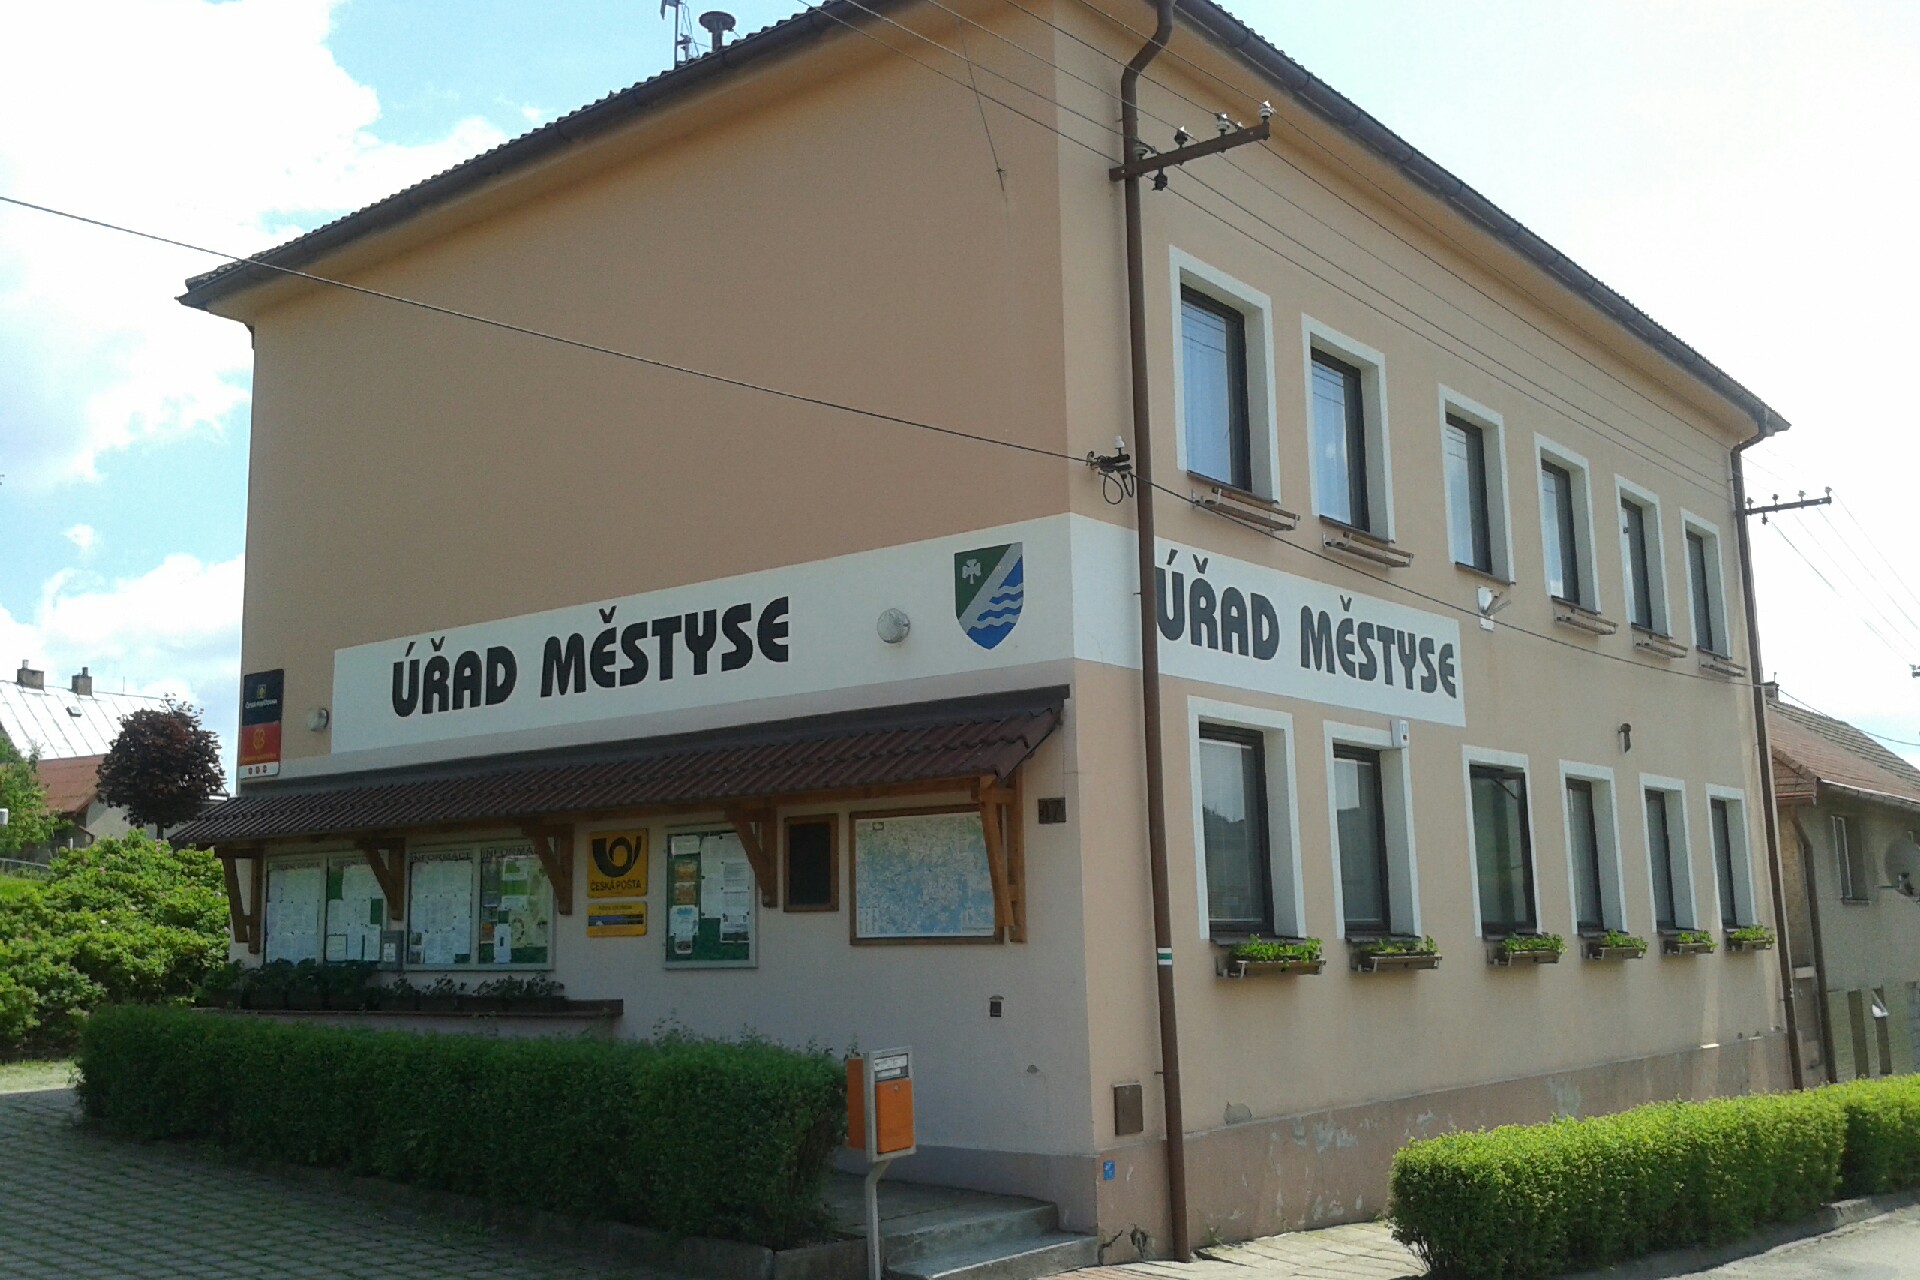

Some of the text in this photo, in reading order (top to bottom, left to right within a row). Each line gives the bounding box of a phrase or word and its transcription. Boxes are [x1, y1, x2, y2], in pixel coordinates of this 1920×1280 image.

[392, 596, 789, 718] ÚŘAD MĚSTYSE
[1155, 549, 1457, 699] ÚŘAD MĚSTYSE
[590, 879, 642, 891] ČESKÁ POŠTA
